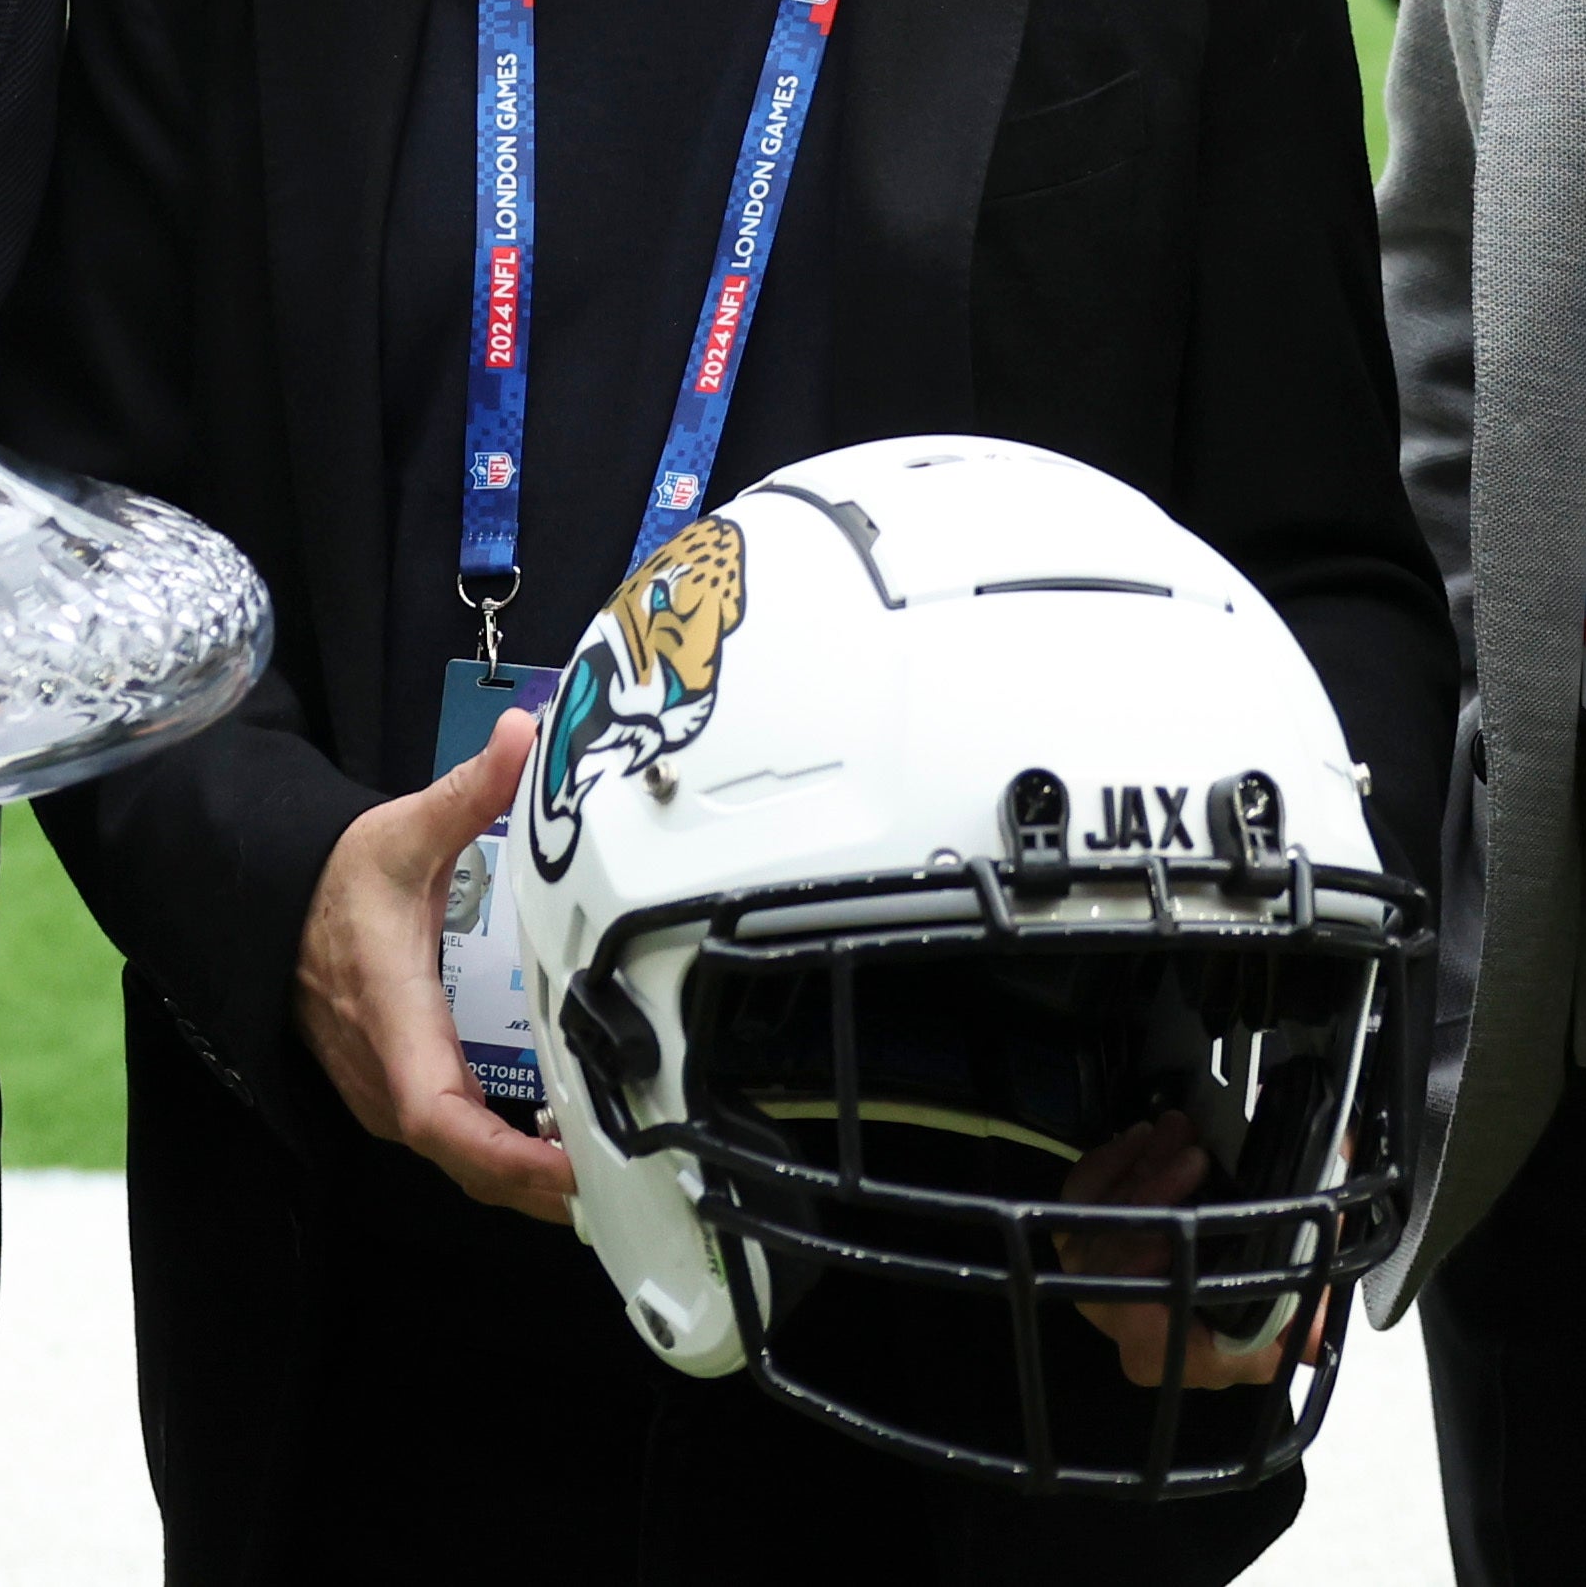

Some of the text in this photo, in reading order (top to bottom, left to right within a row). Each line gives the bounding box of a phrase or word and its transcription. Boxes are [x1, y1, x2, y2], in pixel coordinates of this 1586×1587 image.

[489, 53, 518, 364] 2024 NFL LONDON GAMES
[699, 75, 799, 388] 2024 NFL LONDON GAMES
[489, 456, 506, 484] NFL
[674, 477, 694, 505] NFL
[1084, 786, 1194, 850] JAX
[467, 1062, 535, 1082] OCTOBER
[479, 1080, 535, 1099] CTOBER
